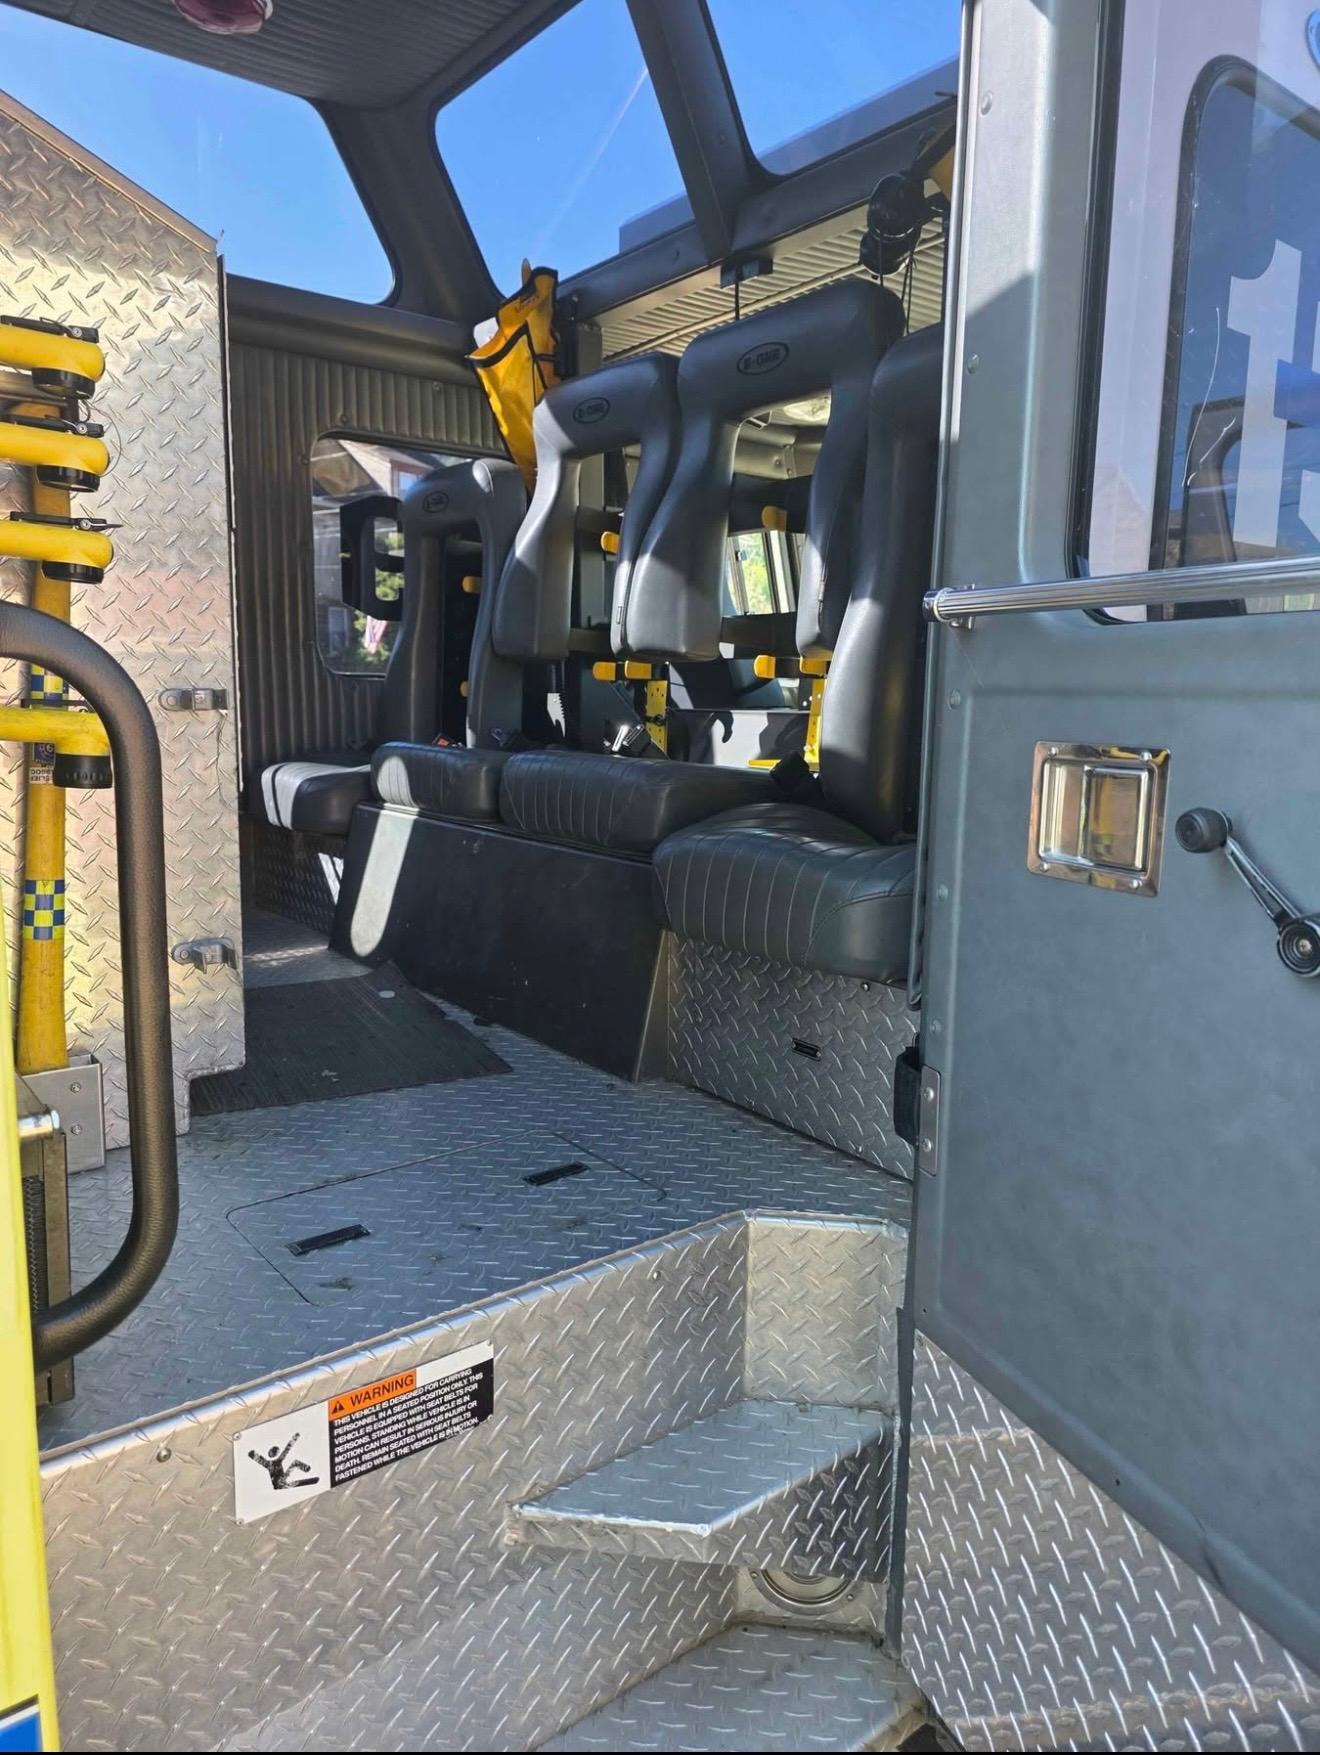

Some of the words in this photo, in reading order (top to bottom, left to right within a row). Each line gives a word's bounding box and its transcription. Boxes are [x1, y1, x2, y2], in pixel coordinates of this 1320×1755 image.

[1227, 239, 1320, 549] 1
[334, 1417, 350, 1427] THIS
[351, 1406, 379, 1421] VEHICLE
[382, 1400, 389, 1408] IS
[390, 1387, 424, 1406] DESIGNED
[425, 1382, 438, 1392] FOR
[440, 1368, 472, 1386] CARRYING
[334, 1416, 377, 1436] PERSONNEL
[393, 1399, 419, 1414] SEATED
[420, 1386, 450, 1402] POSITION
[469, 1372, 483, 1382] THIS
[334, 1430, 365, 1444] VEHICLE
[374, 1410, 408, 1428] EQUIPPED
[409, 1404, 426, 1415] WITH
[426, 1397, 443, 1409] SEAT
[444, 1390, 464, 1403] BELTS
[464, 1383, 478, 1393] FOR
[351, 1375, 414, 1407] WARNING
[372, 1421, 407, 1439] STANDING
[407, 1412, 428, 1426] WHILE
[428, 1400, 456, 1416] VEHICLE
[457, 1397, 464, 1405] IS
[464, 1395, 470, 1403] IN
[334, 1447, 364, 1463] MOTION
[364, 1441, 379, 1451] CAN
[380, 1430, 406, 1447] RESULT
[407, 1426, 415, 1434] IN
[415, 1414, 444, 1431] SERIOUS
[444, 1405, 467, 1419] INJURY
[467, 1400, 477, 1409] OR
[335, 1462, 373, 1481] FASTENED
[374, 1452, 396, 1465] WHILE
[396, 1446, 410, 1456] THE
[410, 1434, 439, 1450] VEHICLE
[439, 1430, 445, 1438] IS
[446, 1427, 453, 1435] IN
[361, 1446, 389, 1461] REMAIN
[390, 1434, 416, 1450] SEATED
[417, 1428, 433, 1439] WITH
[434, 1420, 451, 1432] SEAT
[451, 1412, 472, 1425] BELTS
